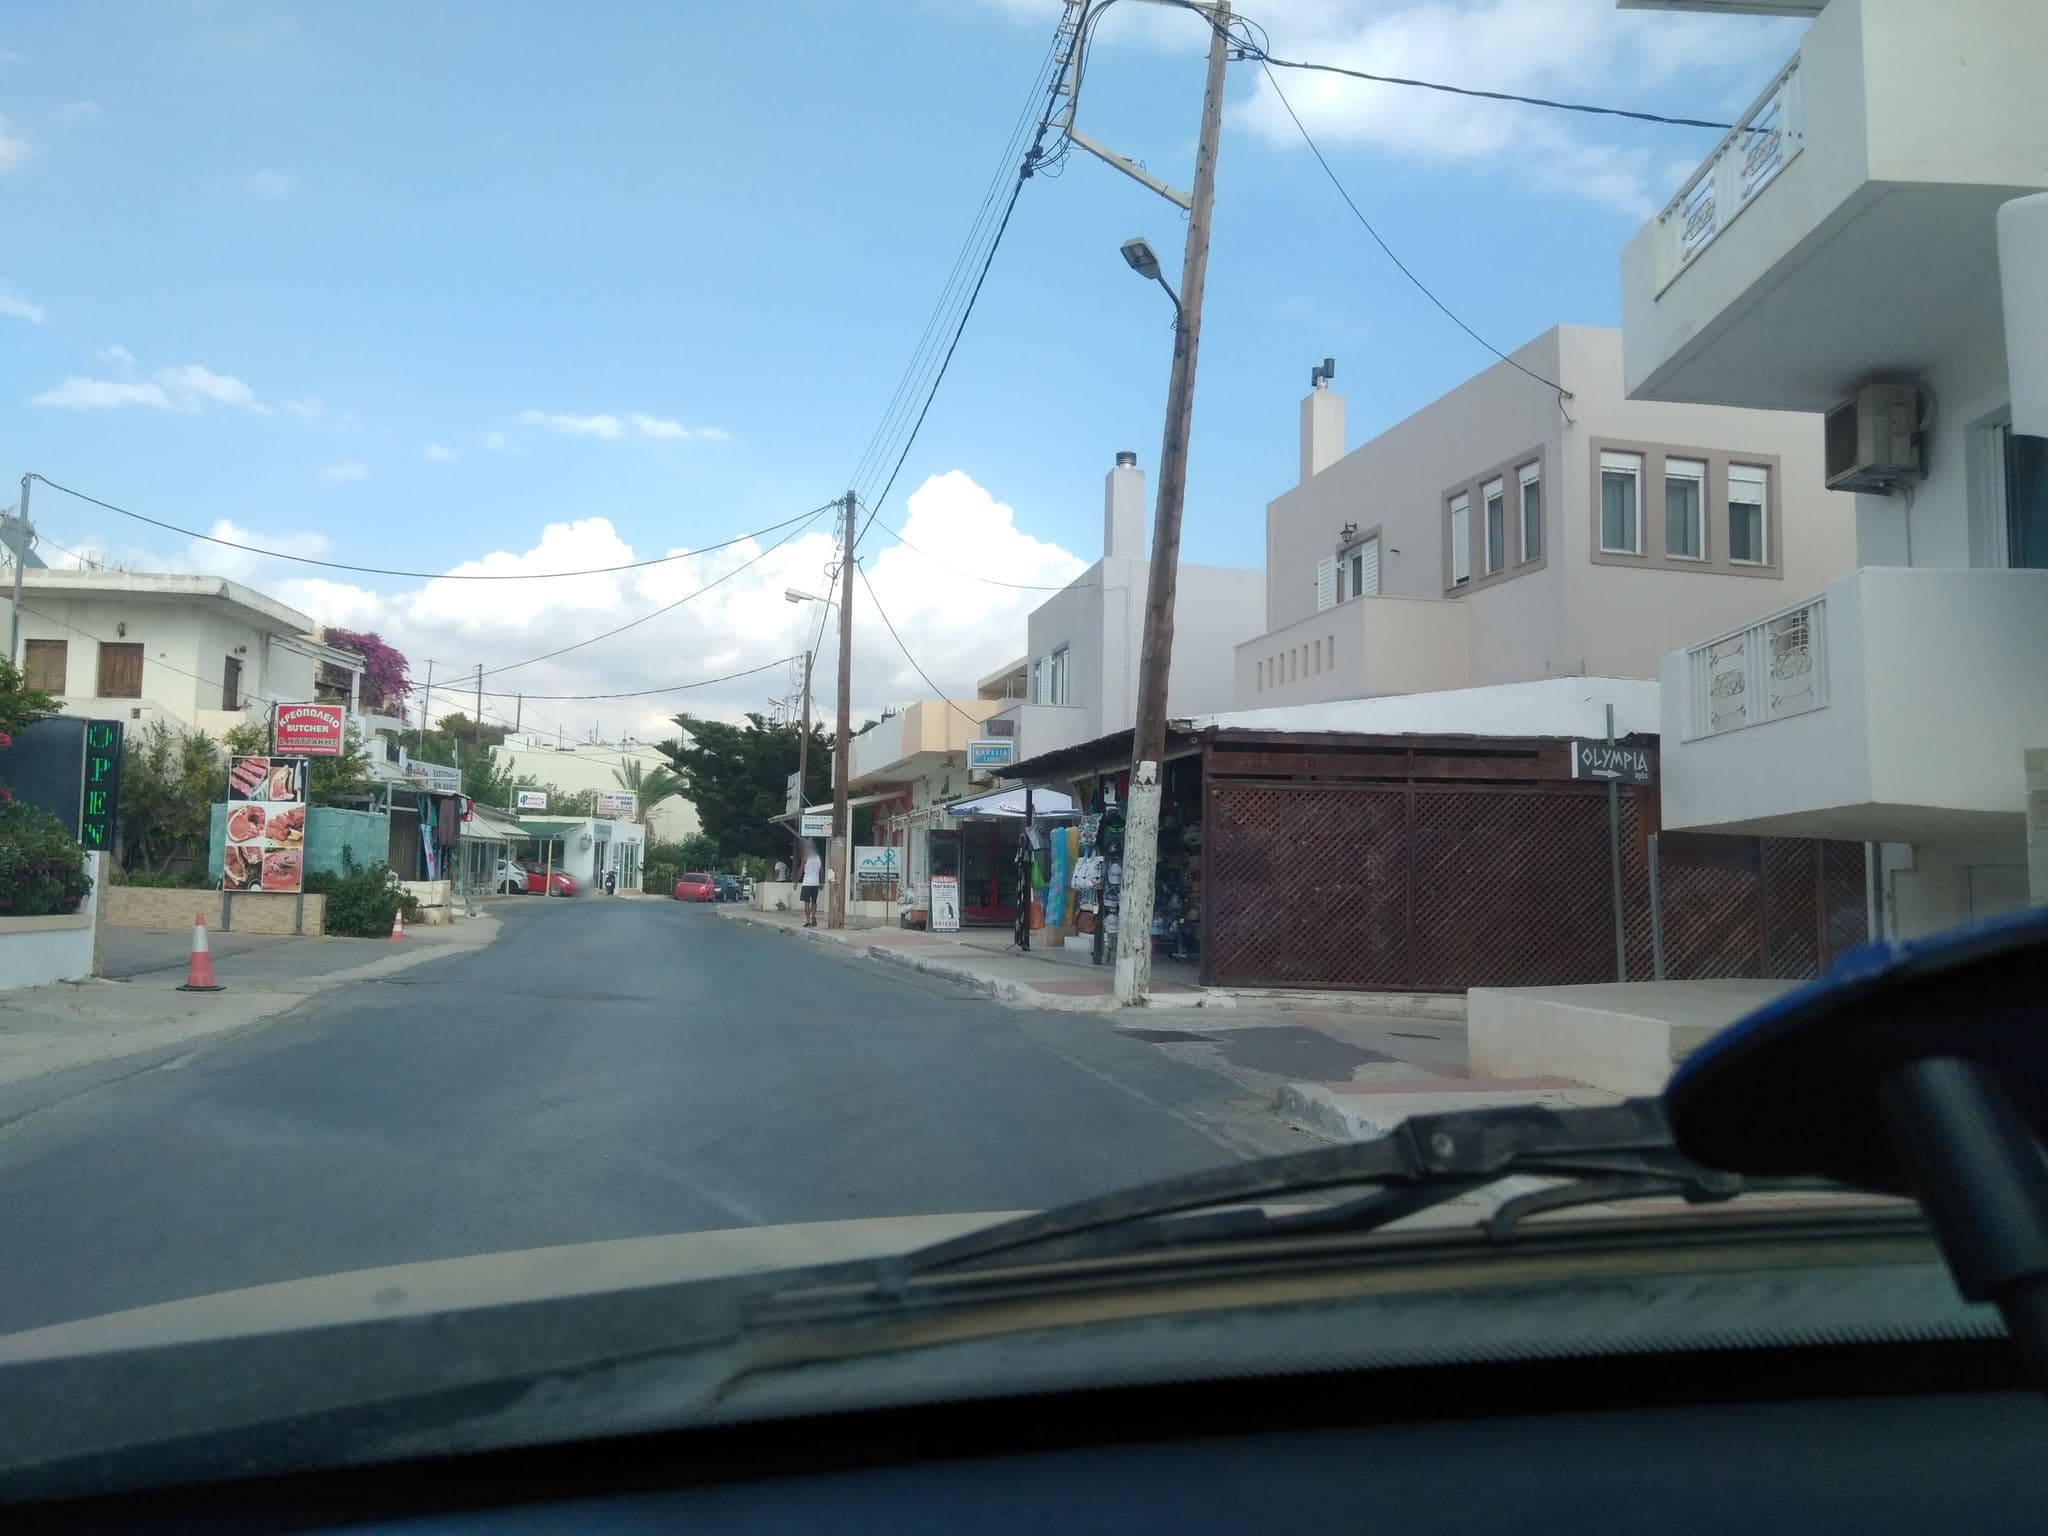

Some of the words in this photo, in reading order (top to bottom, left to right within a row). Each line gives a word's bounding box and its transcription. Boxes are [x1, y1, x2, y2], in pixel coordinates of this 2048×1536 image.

[279, 708, 340, 728] ΚΡΕΟΠΩΛΕΙΟ
[287, 724, 329, 733] BUTCHER
[1582, 747, 1648, 772] OLYMPIA
